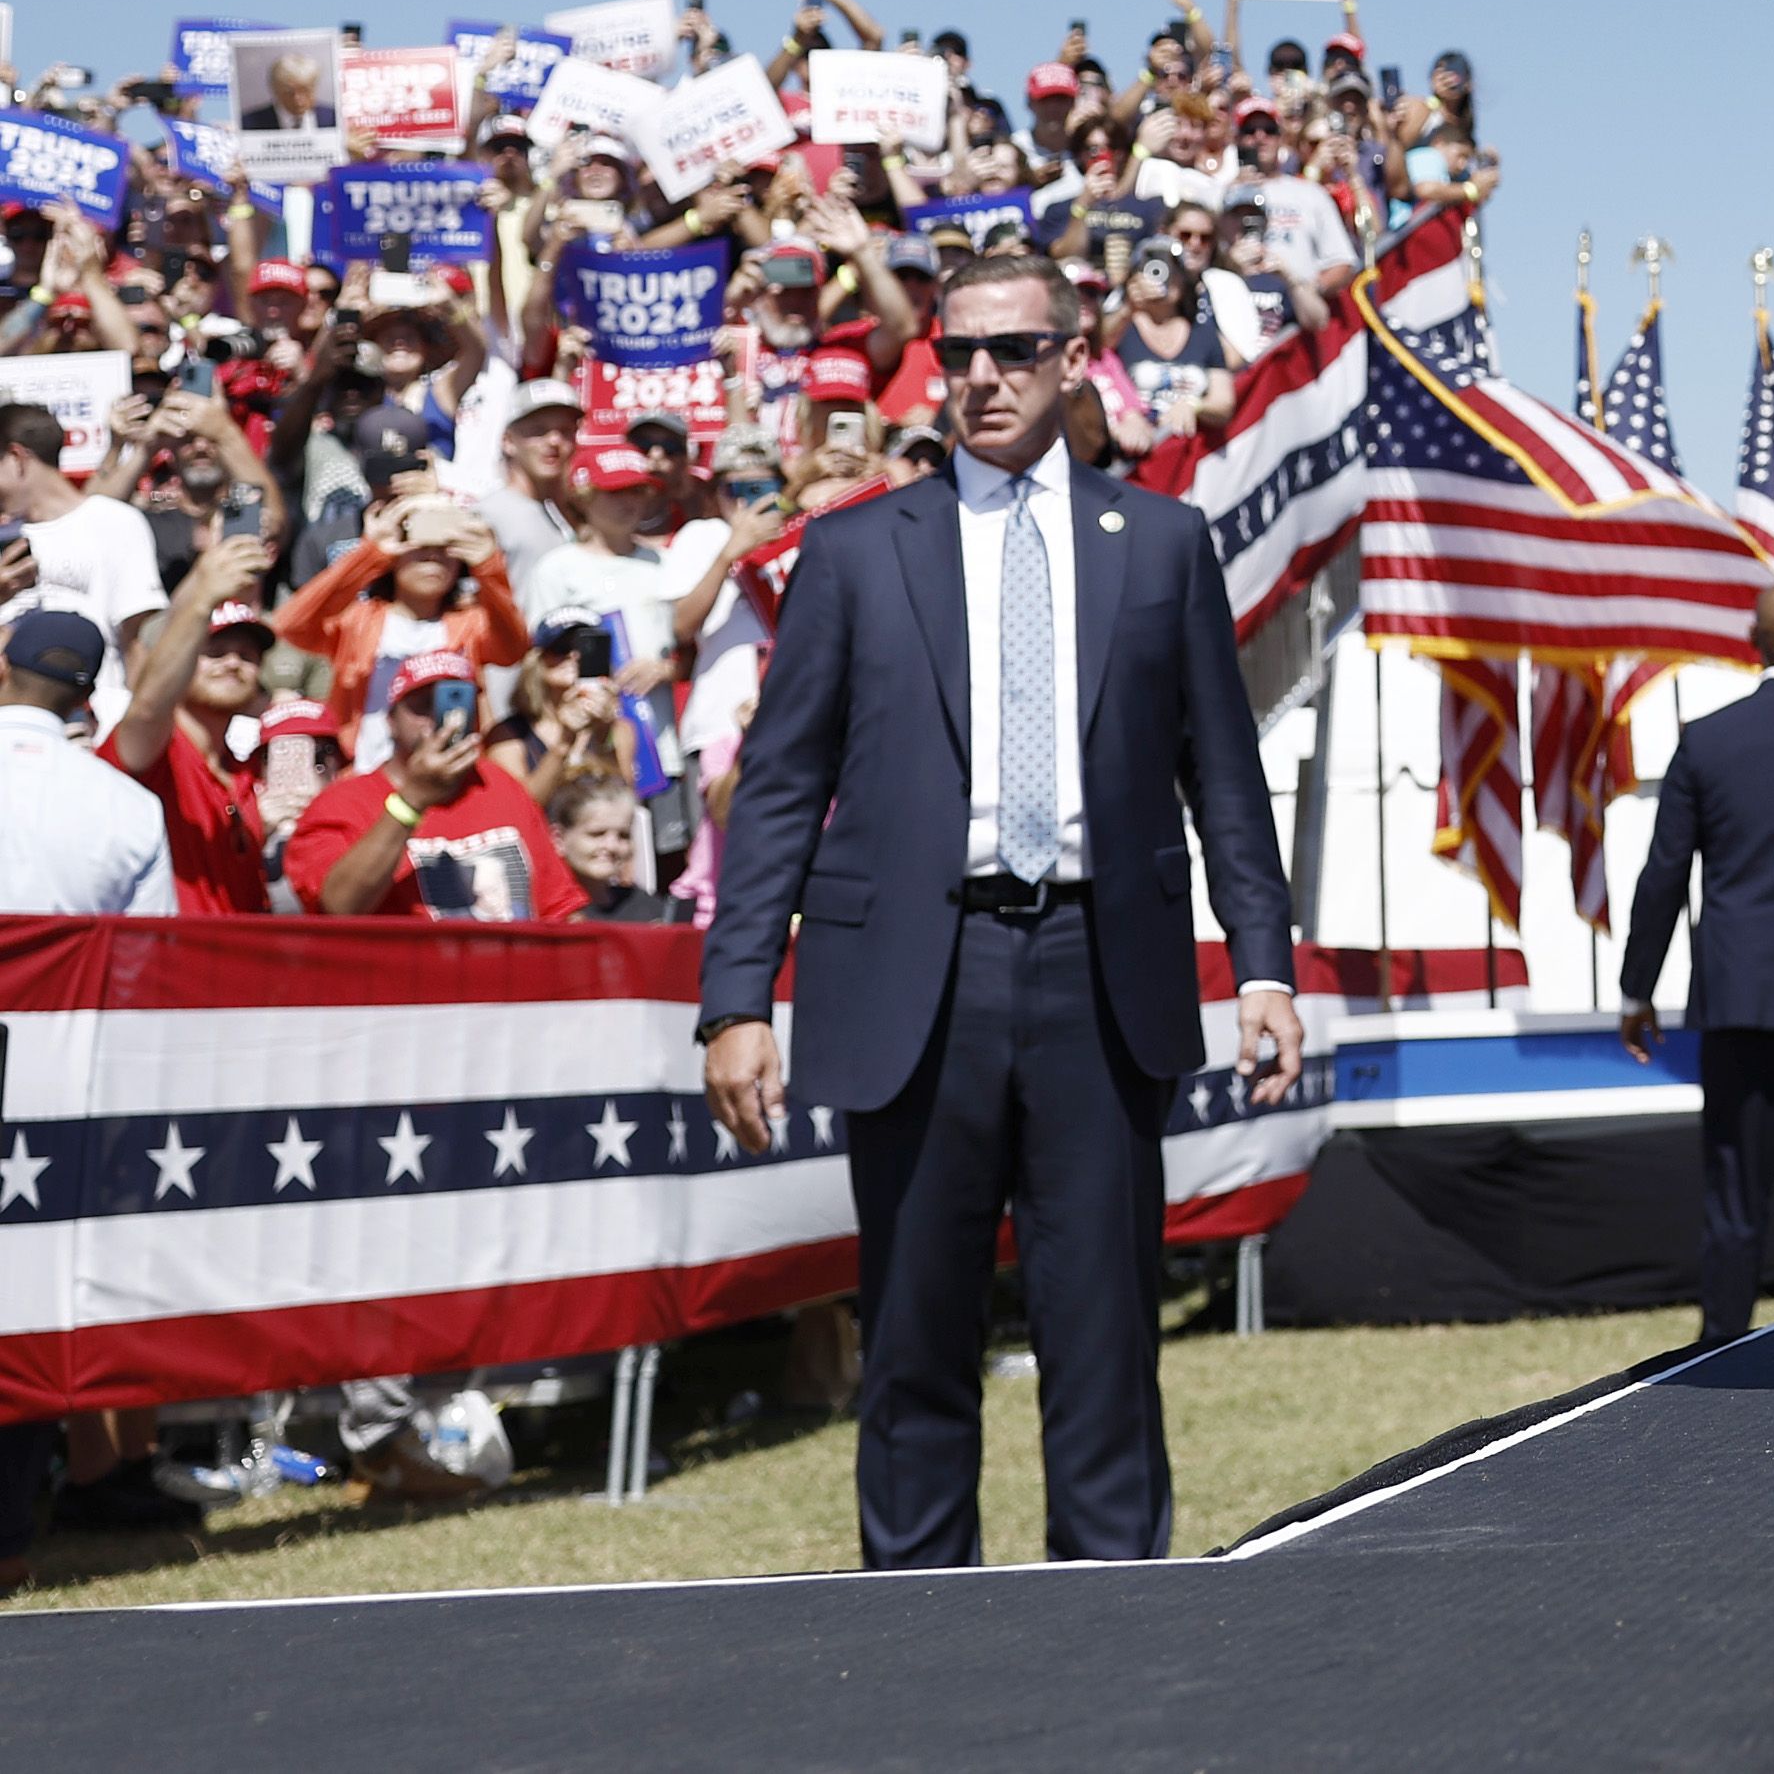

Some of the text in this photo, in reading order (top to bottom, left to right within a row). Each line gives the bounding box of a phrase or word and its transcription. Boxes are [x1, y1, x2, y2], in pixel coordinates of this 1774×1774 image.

[343, 64, 448, 90] RUMP
[664, 101, 747, 149] YOU'RE
[674, 118, 765, 173] FIRED!
[6, 147, 98, 191] 2024
[343, 180, 478, 210] TRUMP
[363, 205, 464, 234] 2024
[576, 265, 718, 306] TRUMP
[597, 299, 702, 336] 2024
[612, 374, 719, 410] 2024
